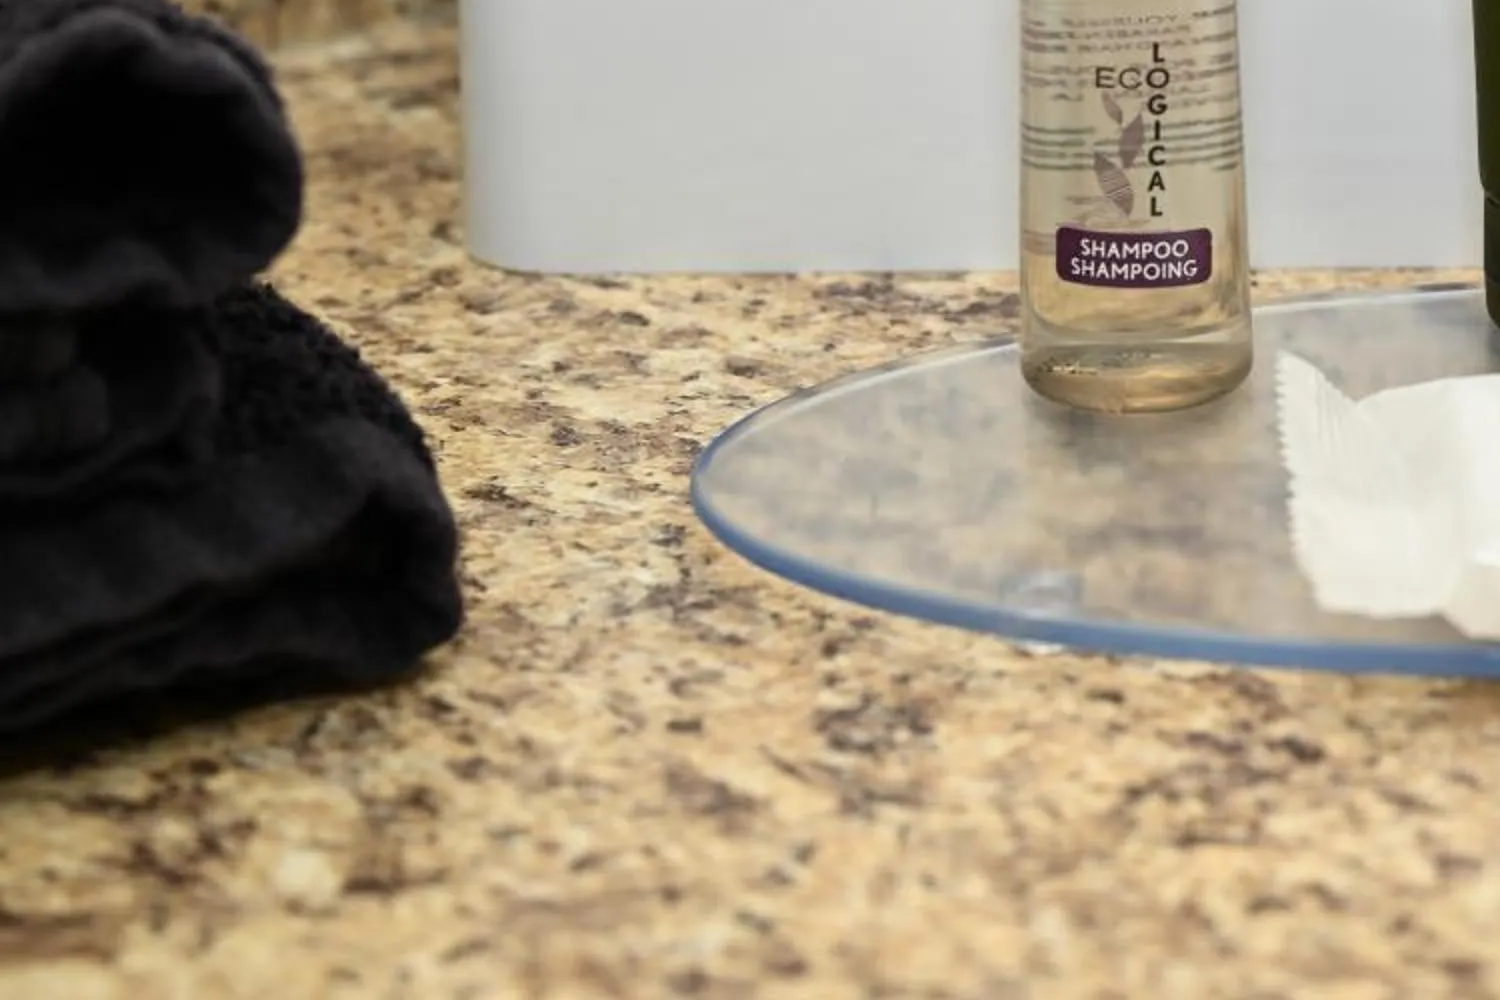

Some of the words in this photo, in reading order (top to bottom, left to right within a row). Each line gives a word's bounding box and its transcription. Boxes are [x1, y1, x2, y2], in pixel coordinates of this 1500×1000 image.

[1095, 67, 1170, 90] ECO
[1146, 42, 1170, 217] LOGICAL
[1081, 238, 1189, 260] SHAMPOO
[1070, 258, 1199, 281] SHAMPOING
